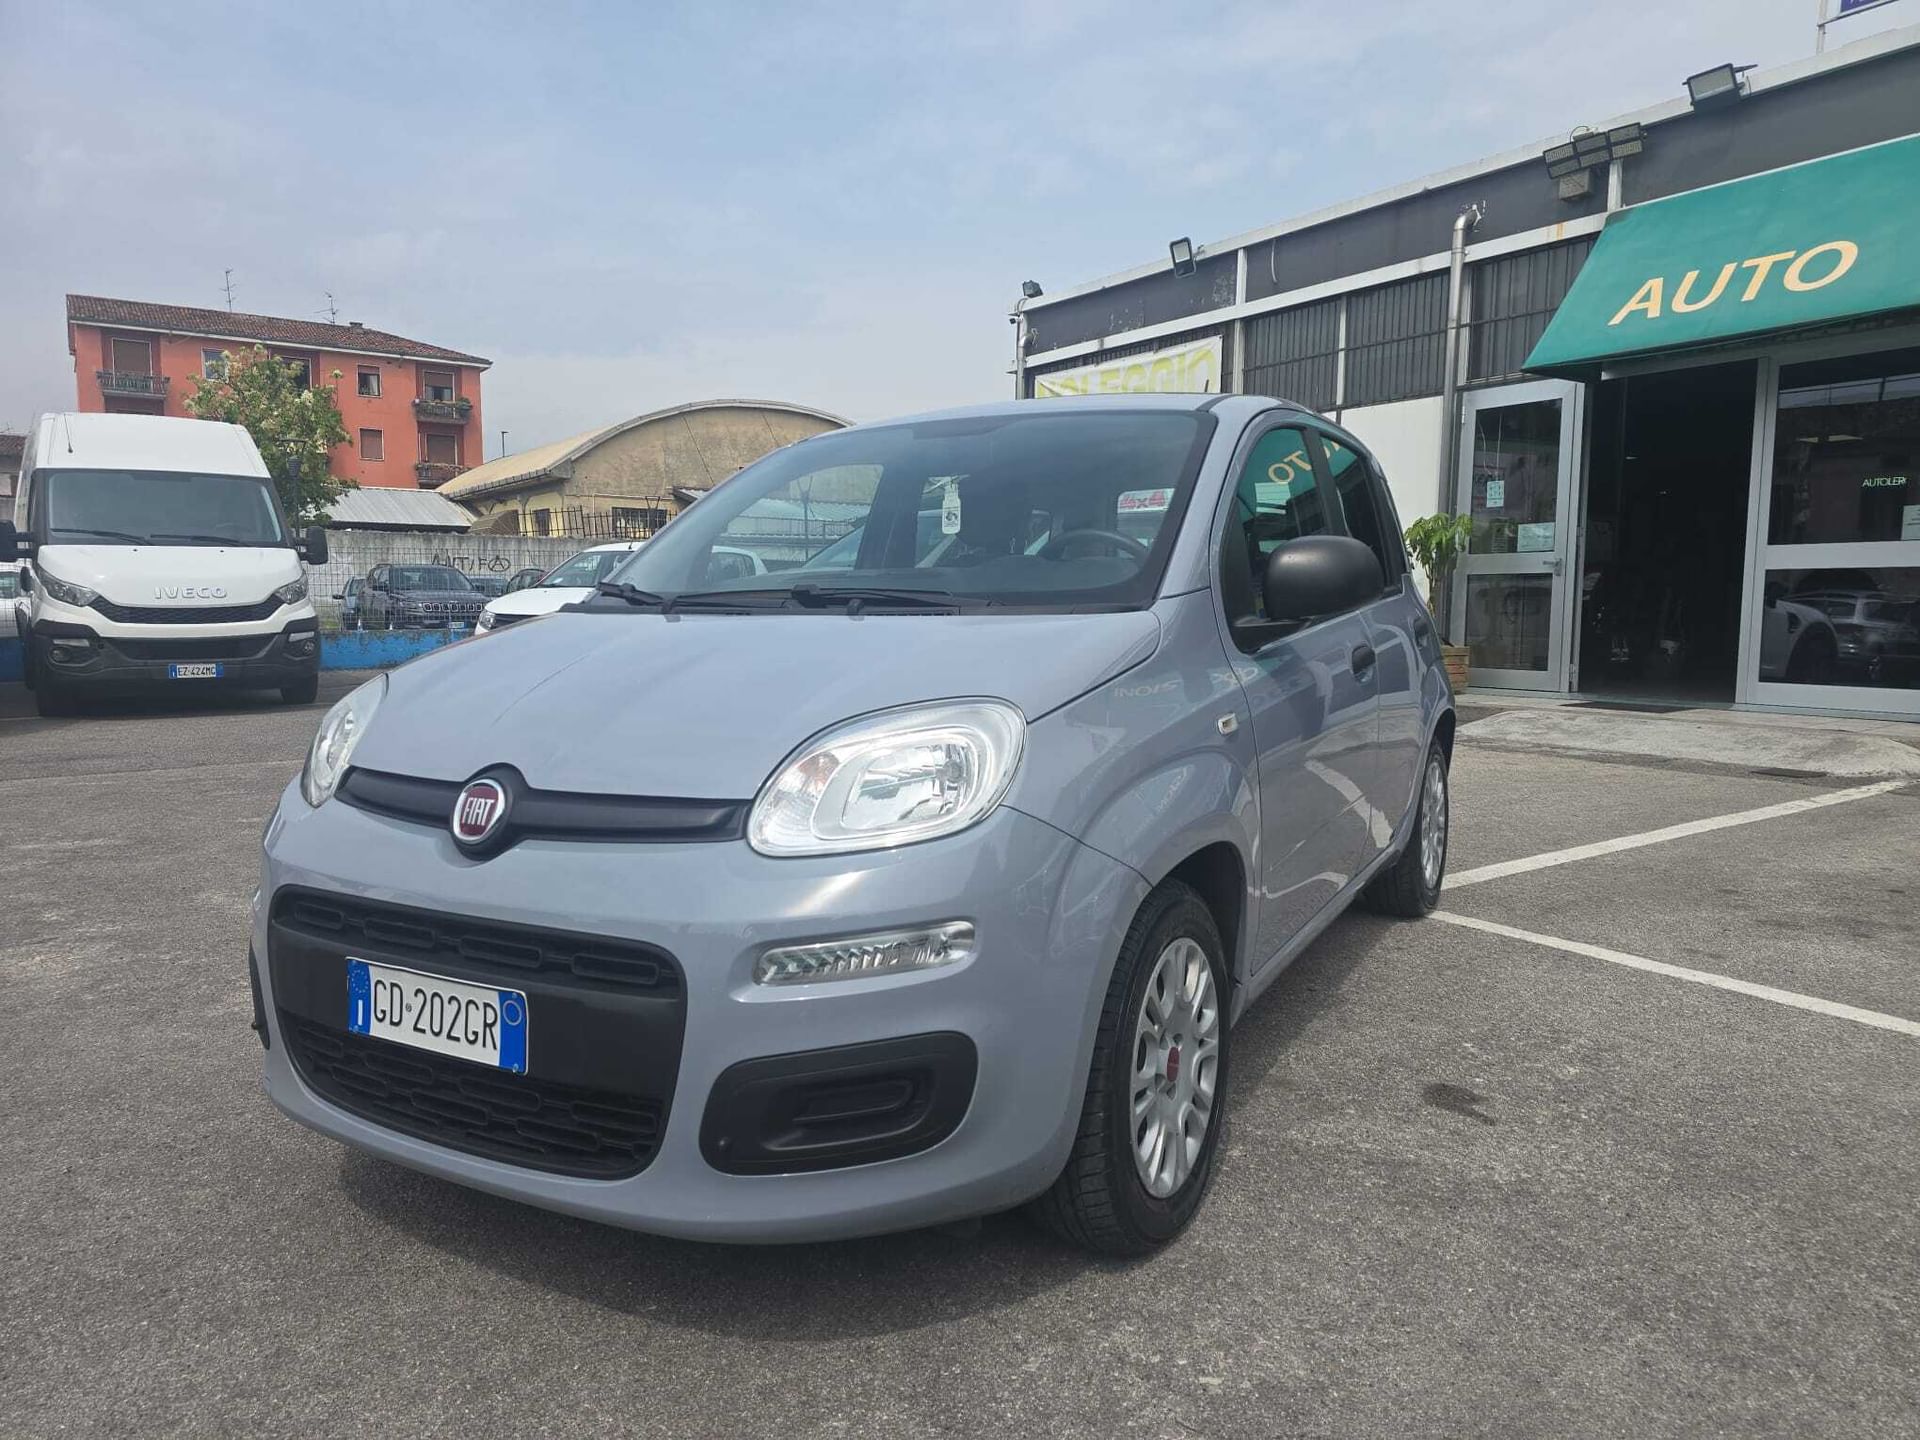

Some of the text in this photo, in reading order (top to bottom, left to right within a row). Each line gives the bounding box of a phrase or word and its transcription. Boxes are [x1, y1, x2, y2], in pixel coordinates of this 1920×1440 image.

[1607, 240, 1859, 327] AUTO
[154, 586, 228, 600] IVECO
[461, 796, 496, 827] FIAT
[373, 978, 404, 1028] GD
[412, 987, 499, 1051] 202GR
